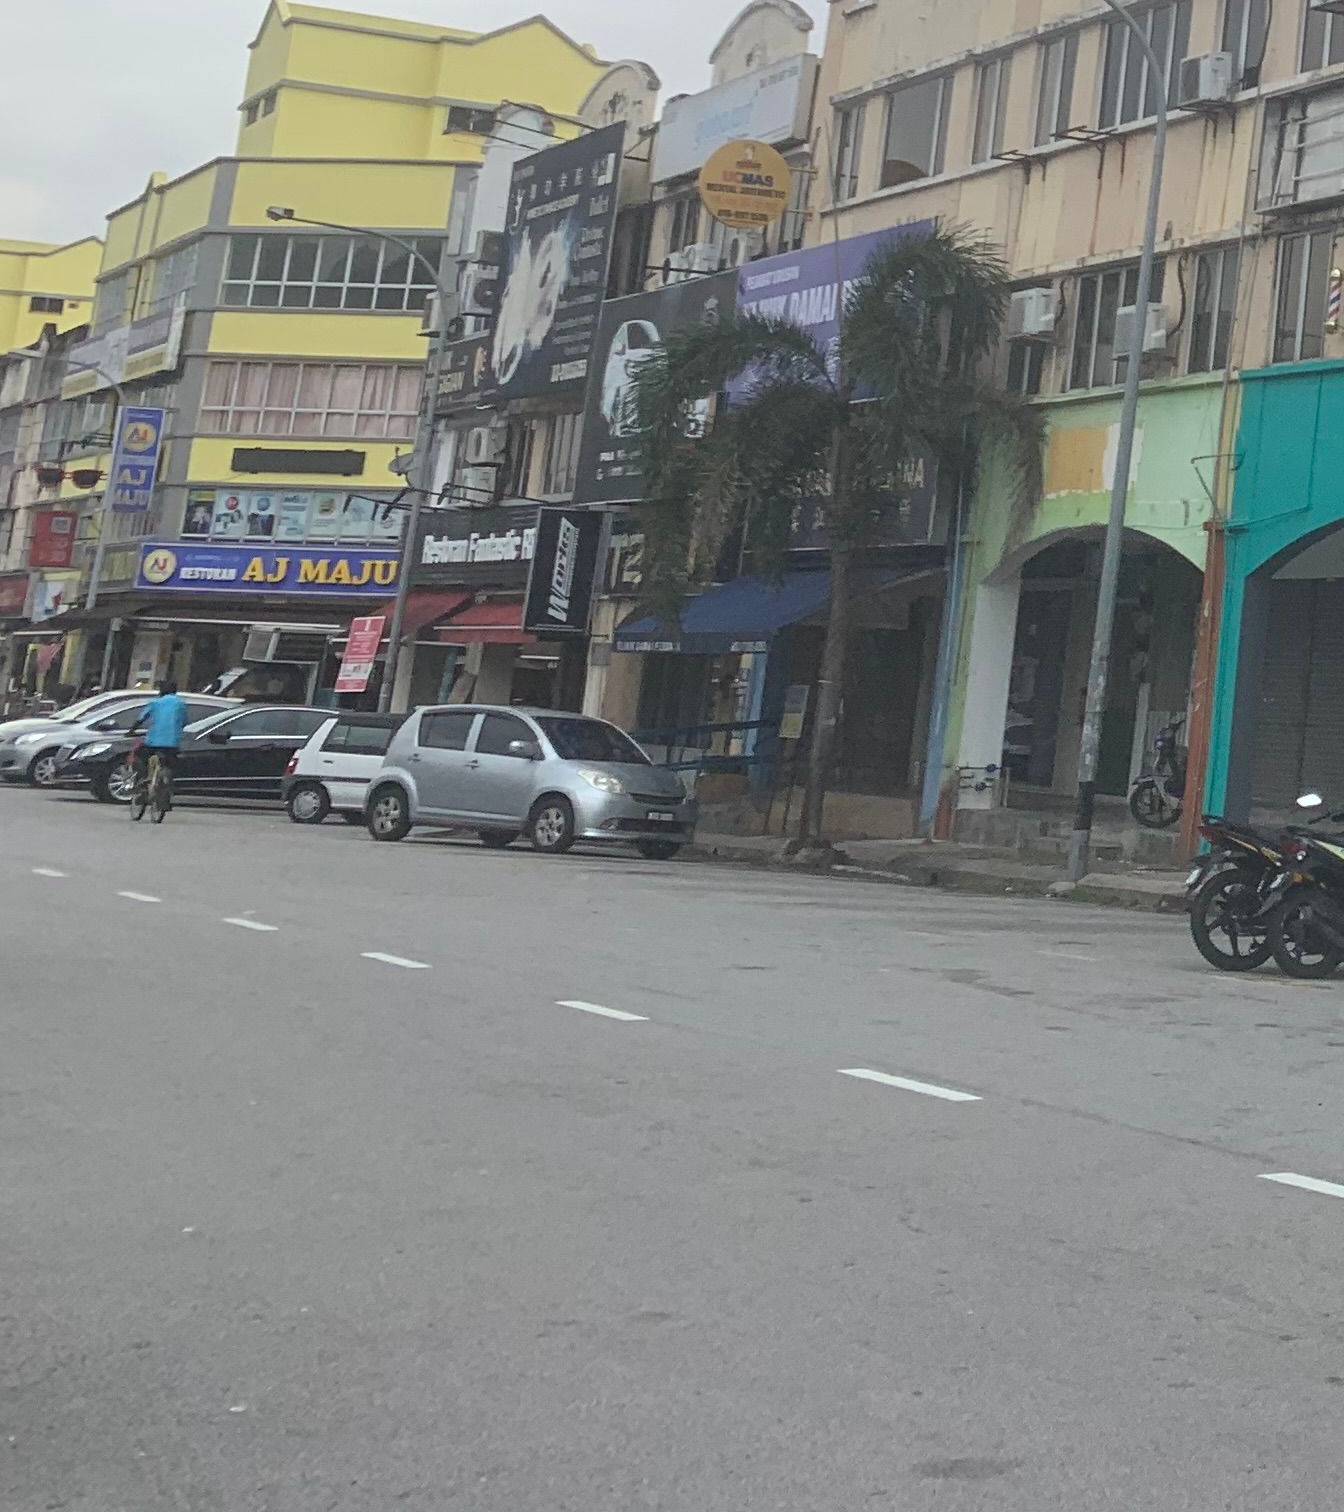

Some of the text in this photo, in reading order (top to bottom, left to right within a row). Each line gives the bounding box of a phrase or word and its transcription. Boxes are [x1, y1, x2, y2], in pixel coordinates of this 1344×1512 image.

[118, 467, 147, 486] AJ
[241, 556, 400, 586] AJ MAJU
